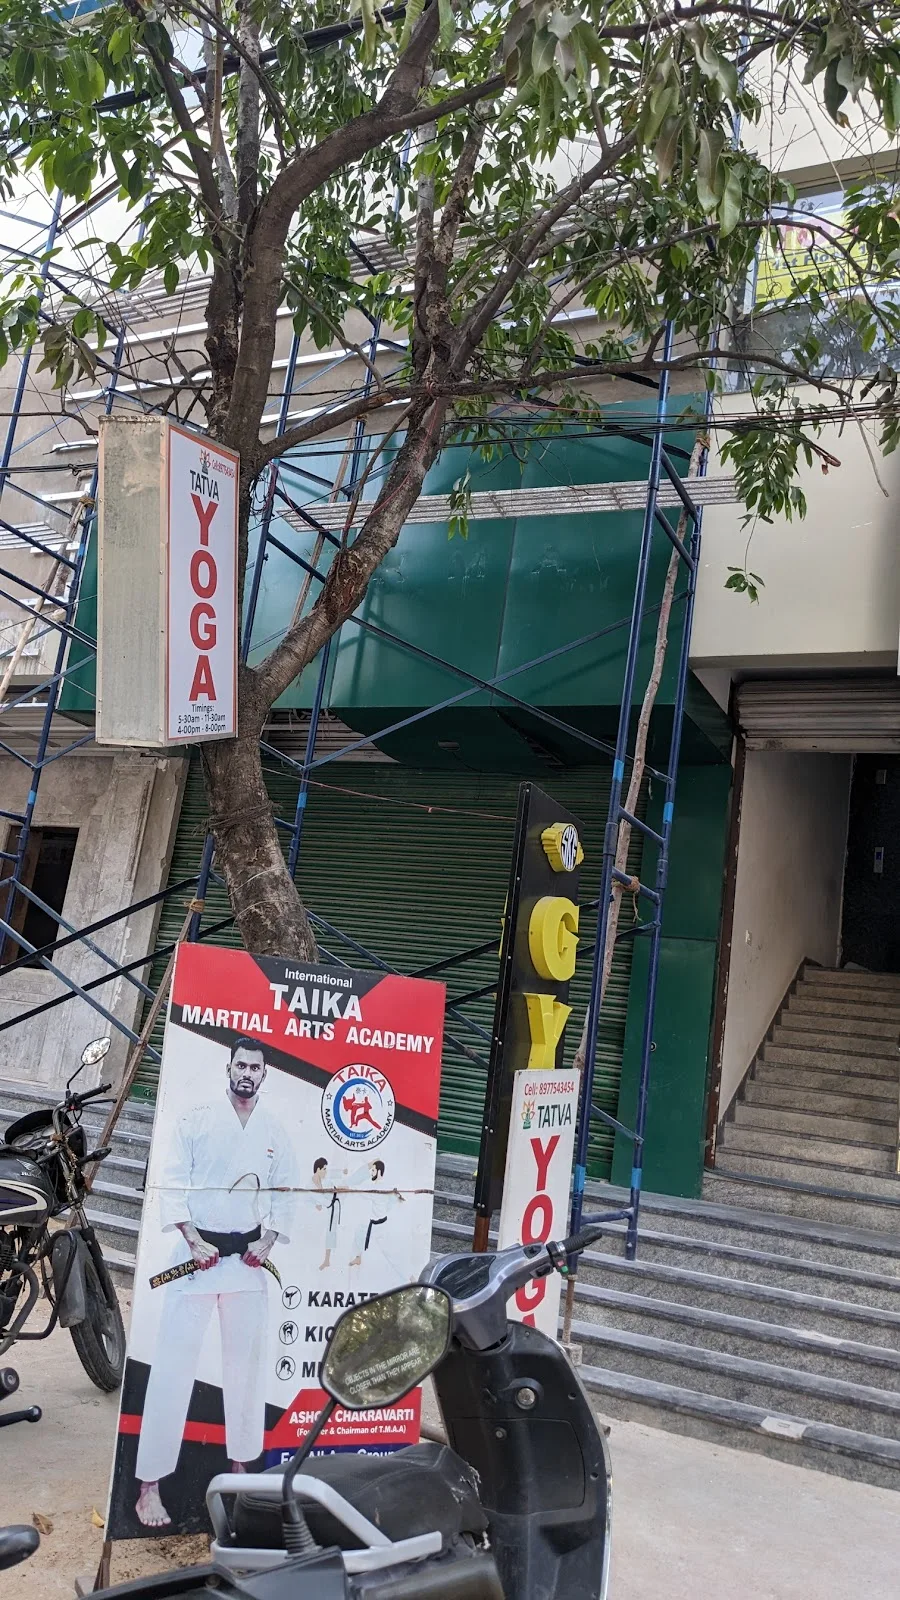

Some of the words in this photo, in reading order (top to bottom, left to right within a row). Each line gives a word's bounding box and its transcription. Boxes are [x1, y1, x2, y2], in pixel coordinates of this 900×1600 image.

[190, 469, 219, 501] TATVA
[189, 493, 219, 701] YOGA
[178, 714, 200, 724] 5-30am
[204, 713, 226, 722] 11-30am
[191, 703, 215, 714] Timings:
[177, 725, 201, 735] 4-00pm
[205, 723, 227, 733] 8-00pm
[285, 968, 353, 989] International
[269, 982, 363, 1022] TAIKA
[181, 1004, 273, 1034] MARTIAL
[284, 1018, 335, 1041] ARTS
[346, 1027, 435, 1054] ACADEMY
[332, 1065, 387, 1093] TAIKA
[524, 1082, 538, 1096] Cell:
[539, 1081, 575, 1095] 8977543454
[325, 1108, 344, 1143] MARTIAL
[344, 1139, 366, 1148] ARTS
[367, 1111, 393, 1147] ACADEMY
[537, 1103, 572, 1128] TATVA
[344, 1370, 370, 1386] OBJECTS
[369, 1366, 376, 1377] IN
[375, 1360, 387, 1372] THE
[386, 1352, 409, 1367] MIRROR
[408, 1346, 421, 1357] ARE
[349, 1380, 372, 1395] CLOSER
[371, 1373, 387, 1385] THAN
[386, 1366, 401, 1378] THEY
[400, 1357, 423, 1372] APPEAR
[289, 1411, 332, 1424] ASHO
[335, 1409, 414, 1422] CHAKRAVARTI
[297, 1427, 328, 1438] (Foer
[329, 1427, 335, 1435] &
[337, 1426, 369, 1435] Chairman
[370, 1425, 378, 1433] of
[378, 1425, 406, 1434] T.M.A.A)
